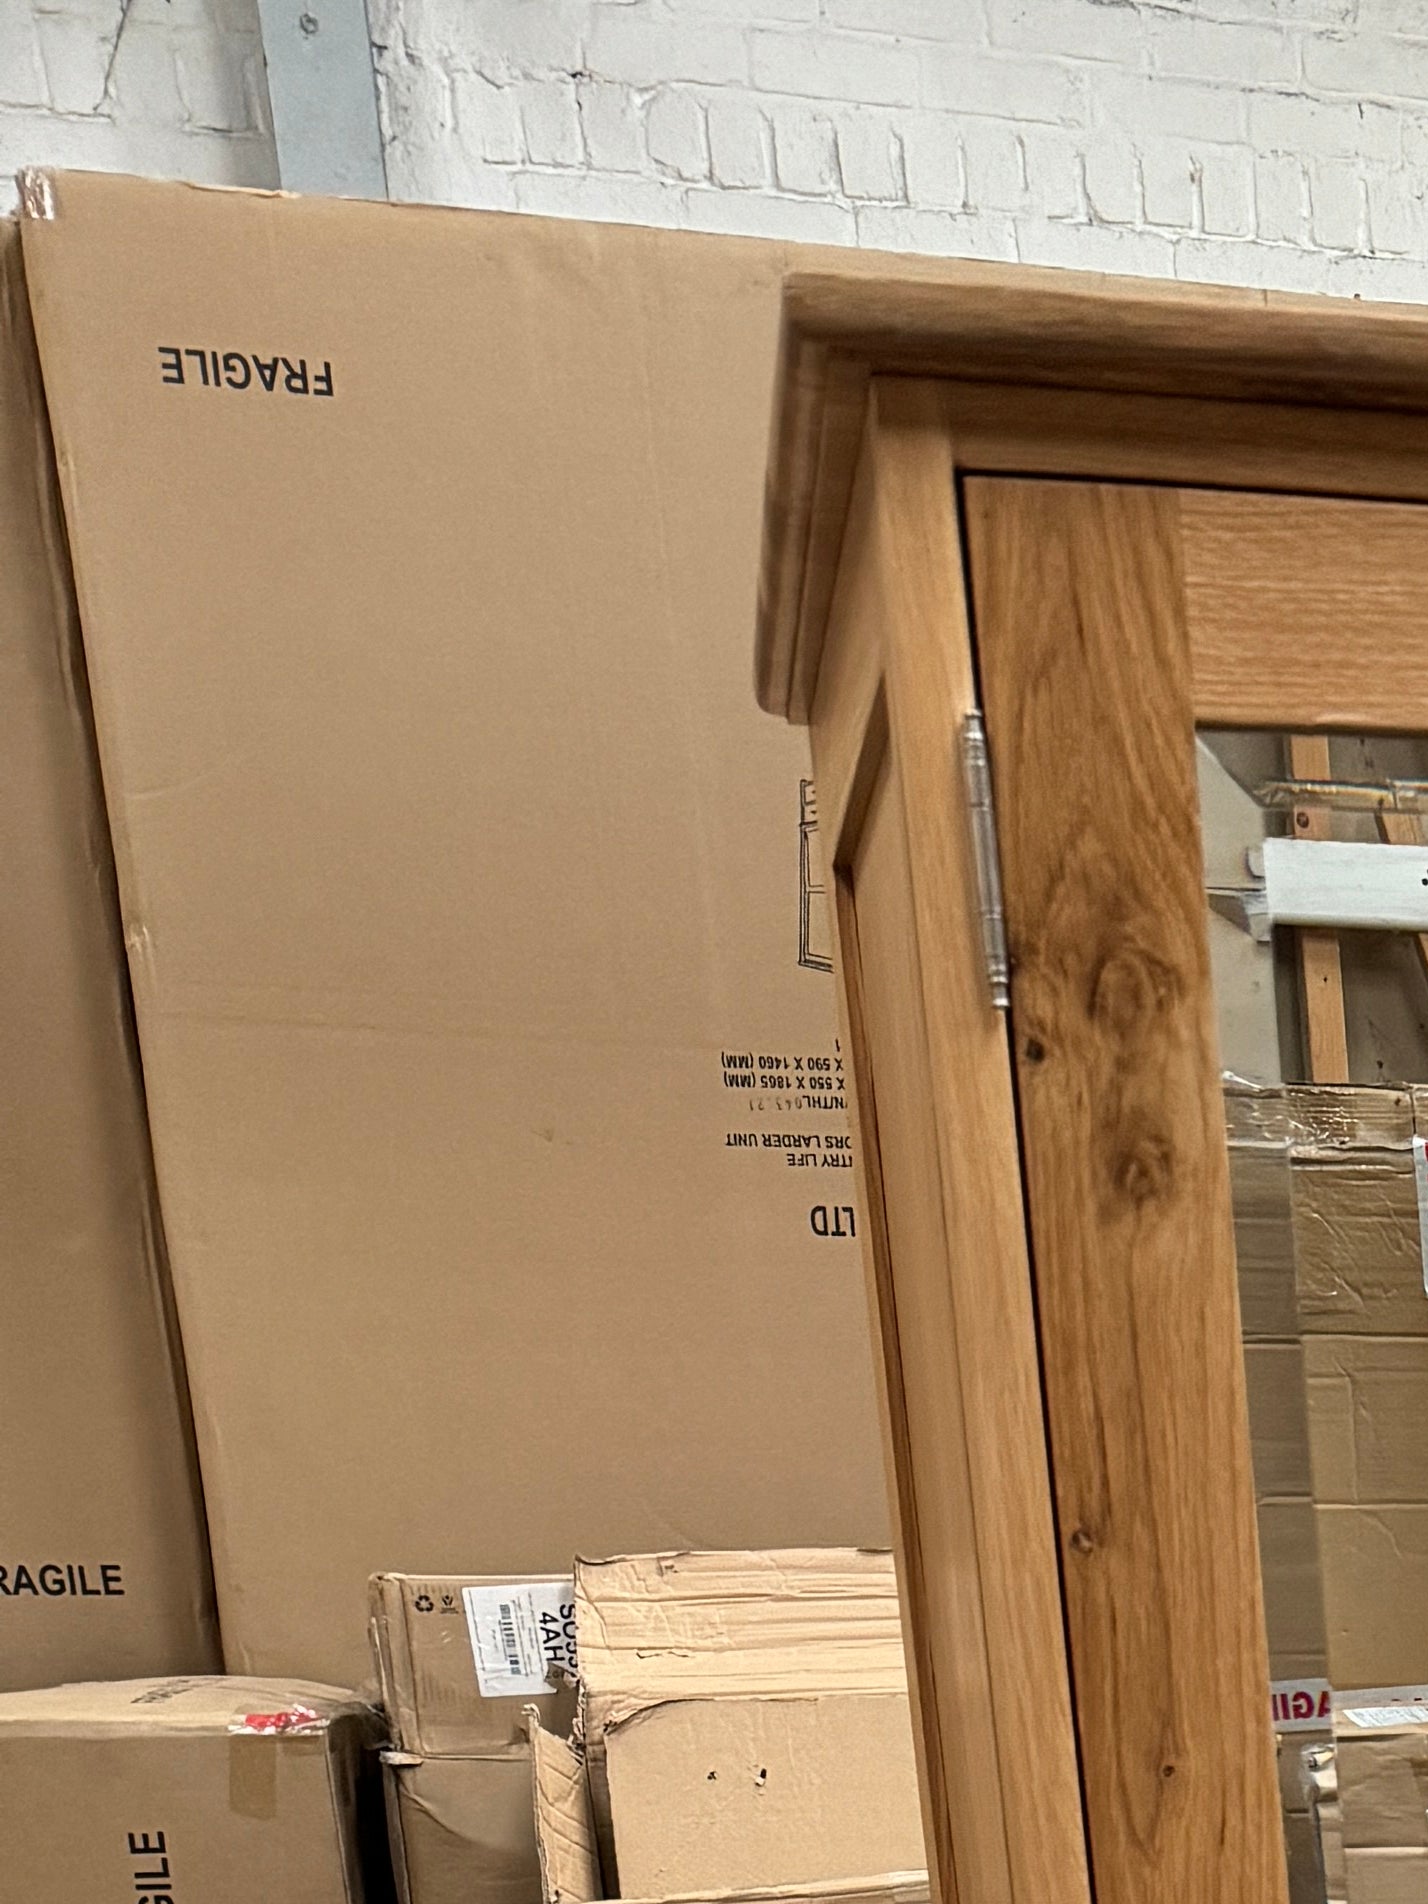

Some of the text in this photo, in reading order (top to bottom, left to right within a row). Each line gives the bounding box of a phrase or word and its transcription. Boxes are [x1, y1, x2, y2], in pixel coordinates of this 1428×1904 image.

[154, 344, 336, 400] FRAGILE
[721, 1051, 753, 1067] (MM)
[793, 1057, 802, 1069] X
[807, 1057, 829, 1070] 590
[723, 1071, 755, 1087] (MM)
[795, 1076, 804, 1088] X
[809, 1077, 832, 1089] 550
[725, 1133, 757, 1146] UNIT
[761, 1133, 820, 1148] LARDER
[786, 1153, 817, 1166] LIFE
[809, 1205, 856, 1236] LTD
[539, 1612, 564, 1661] 4AH
